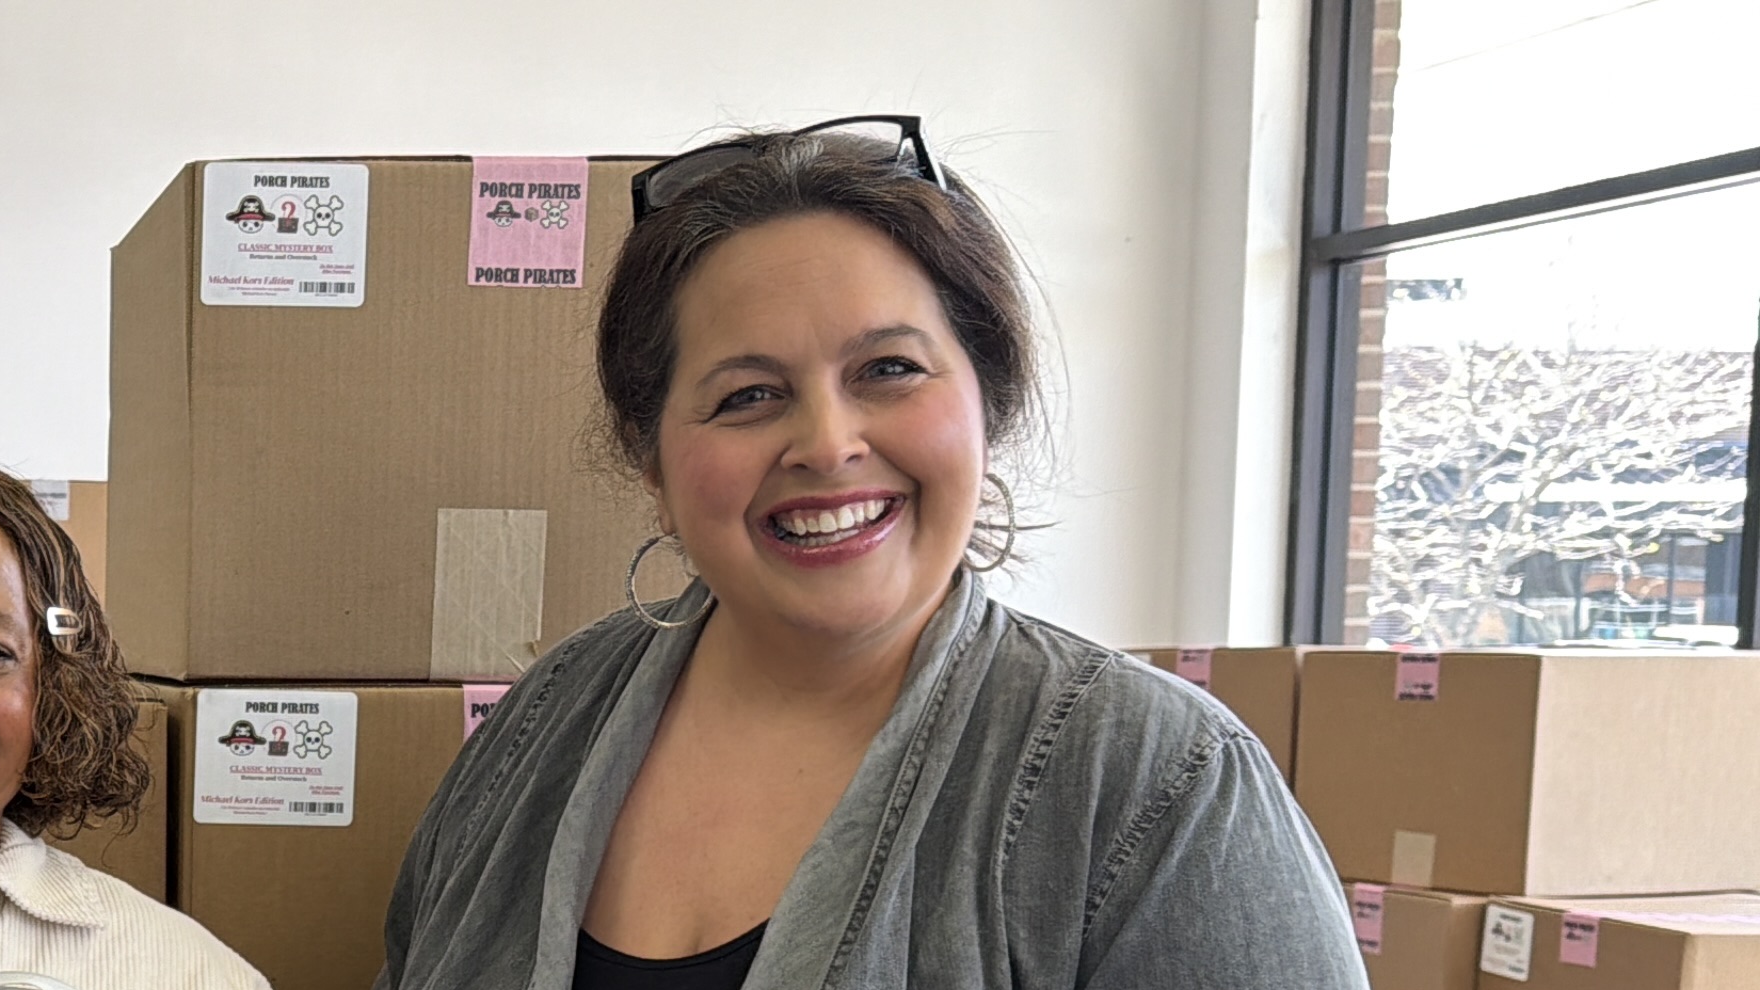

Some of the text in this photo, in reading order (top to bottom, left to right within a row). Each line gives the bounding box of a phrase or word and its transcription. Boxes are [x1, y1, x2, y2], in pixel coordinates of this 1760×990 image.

[254, 175, 330, 188] PORCH PIRATES
[479, 182, 581, 199] PORCH PIRATES
[475, 267, 576, 284] PORCH PIRATES
[245, 702, 319, 714] PORCH PIRATES
